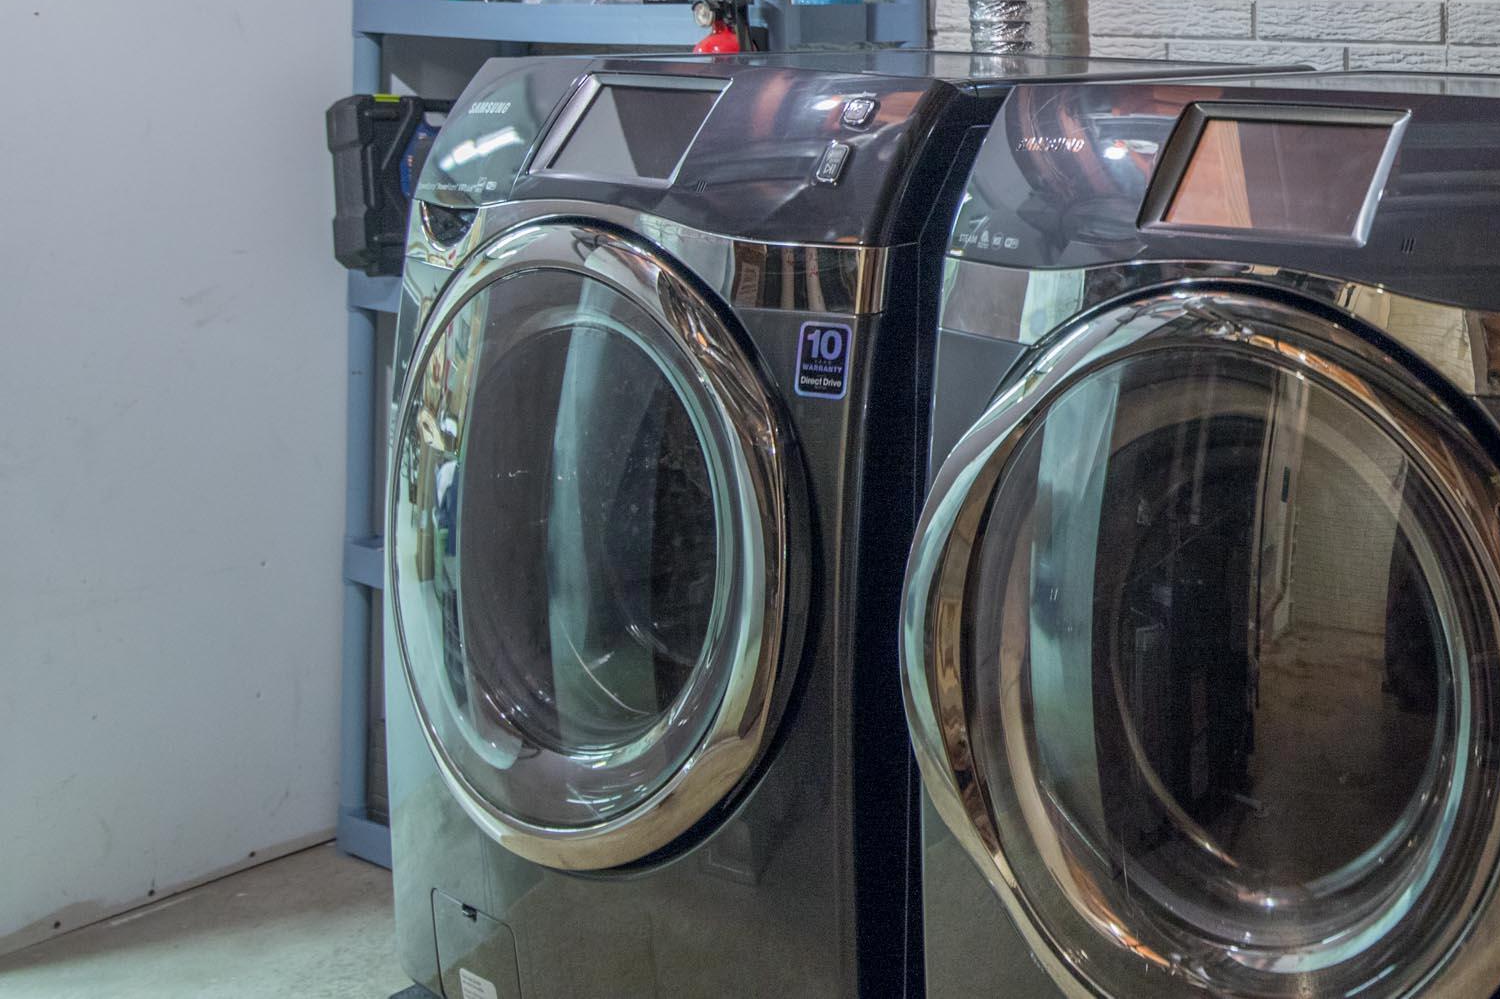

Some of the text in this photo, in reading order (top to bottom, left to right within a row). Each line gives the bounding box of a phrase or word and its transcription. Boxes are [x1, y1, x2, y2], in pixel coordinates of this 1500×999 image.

[468, 102, 511, 114] SAMSUNG
[807, 329, 843, 360] 10
[802, 363, 842, 373] WARRANTY
[800, 376, 842, 387] Direct Drive
